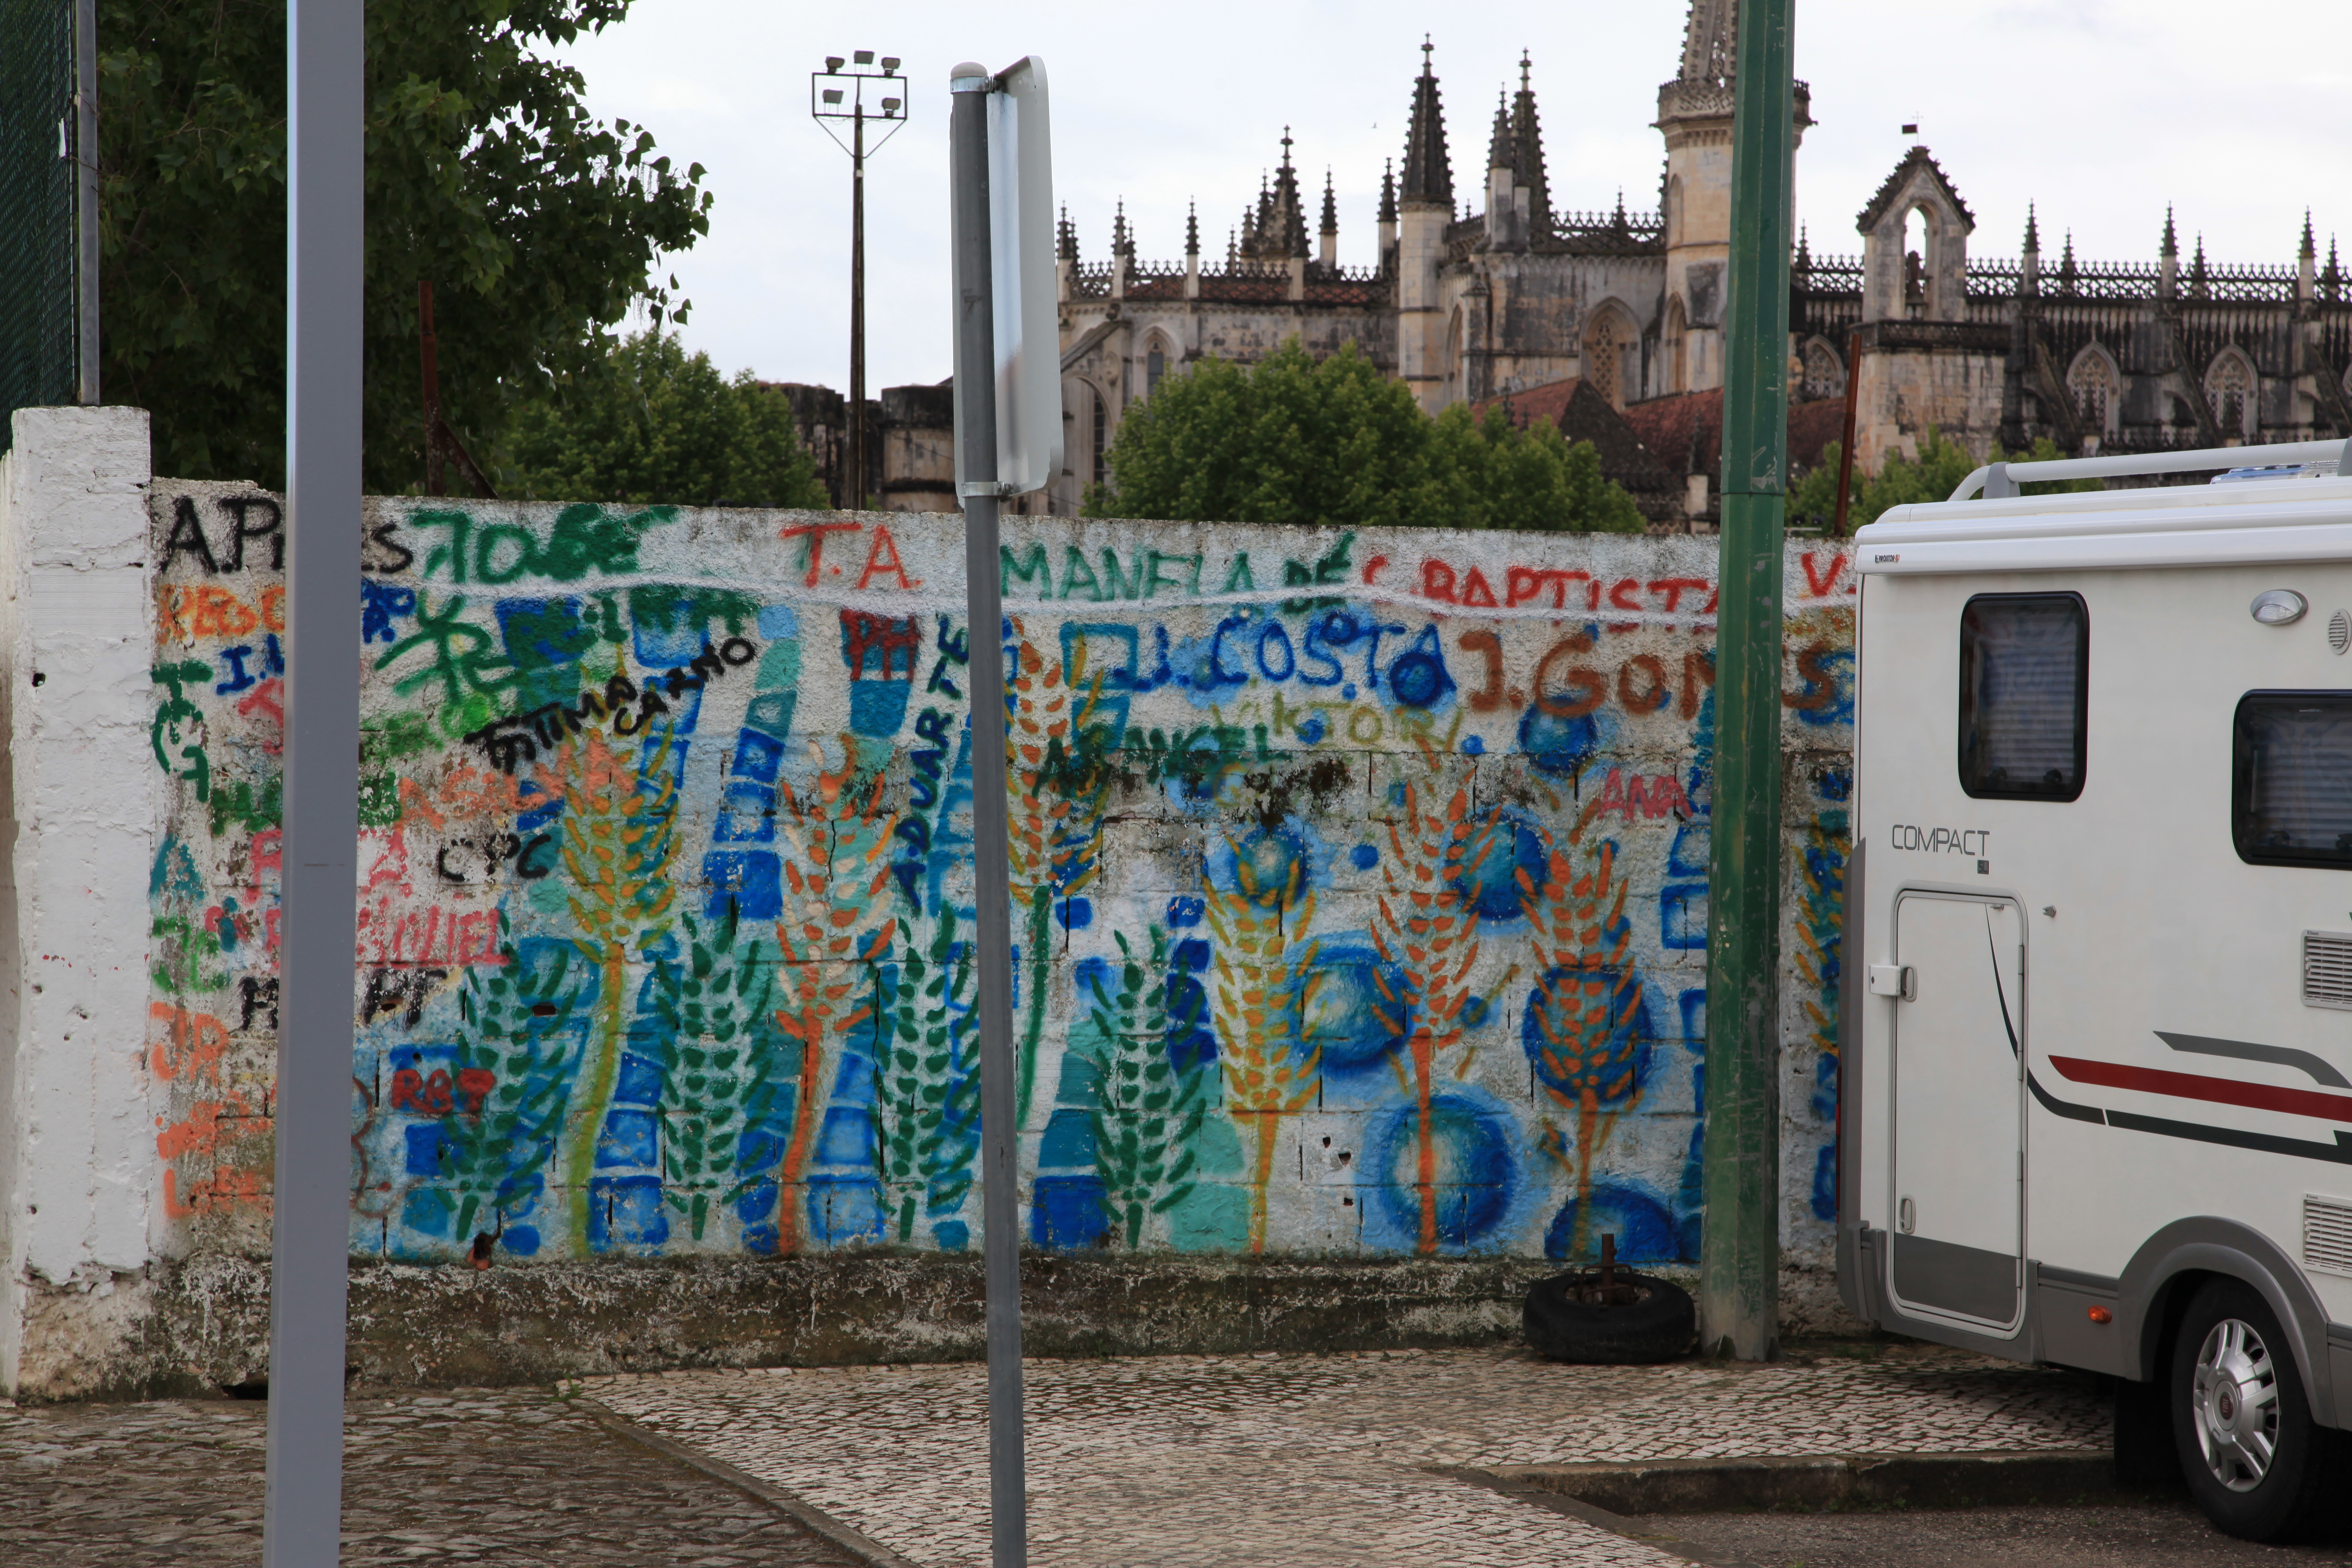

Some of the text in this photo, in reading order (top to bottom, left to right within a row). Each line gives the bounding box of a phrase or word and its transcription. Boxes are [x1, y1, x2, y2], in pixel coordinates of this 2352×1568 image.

[1595, 766, 1694, 823] ANA
[1892, 824, 1990, 857] COMPACT
[1978, 861, 1988, 873] SL
